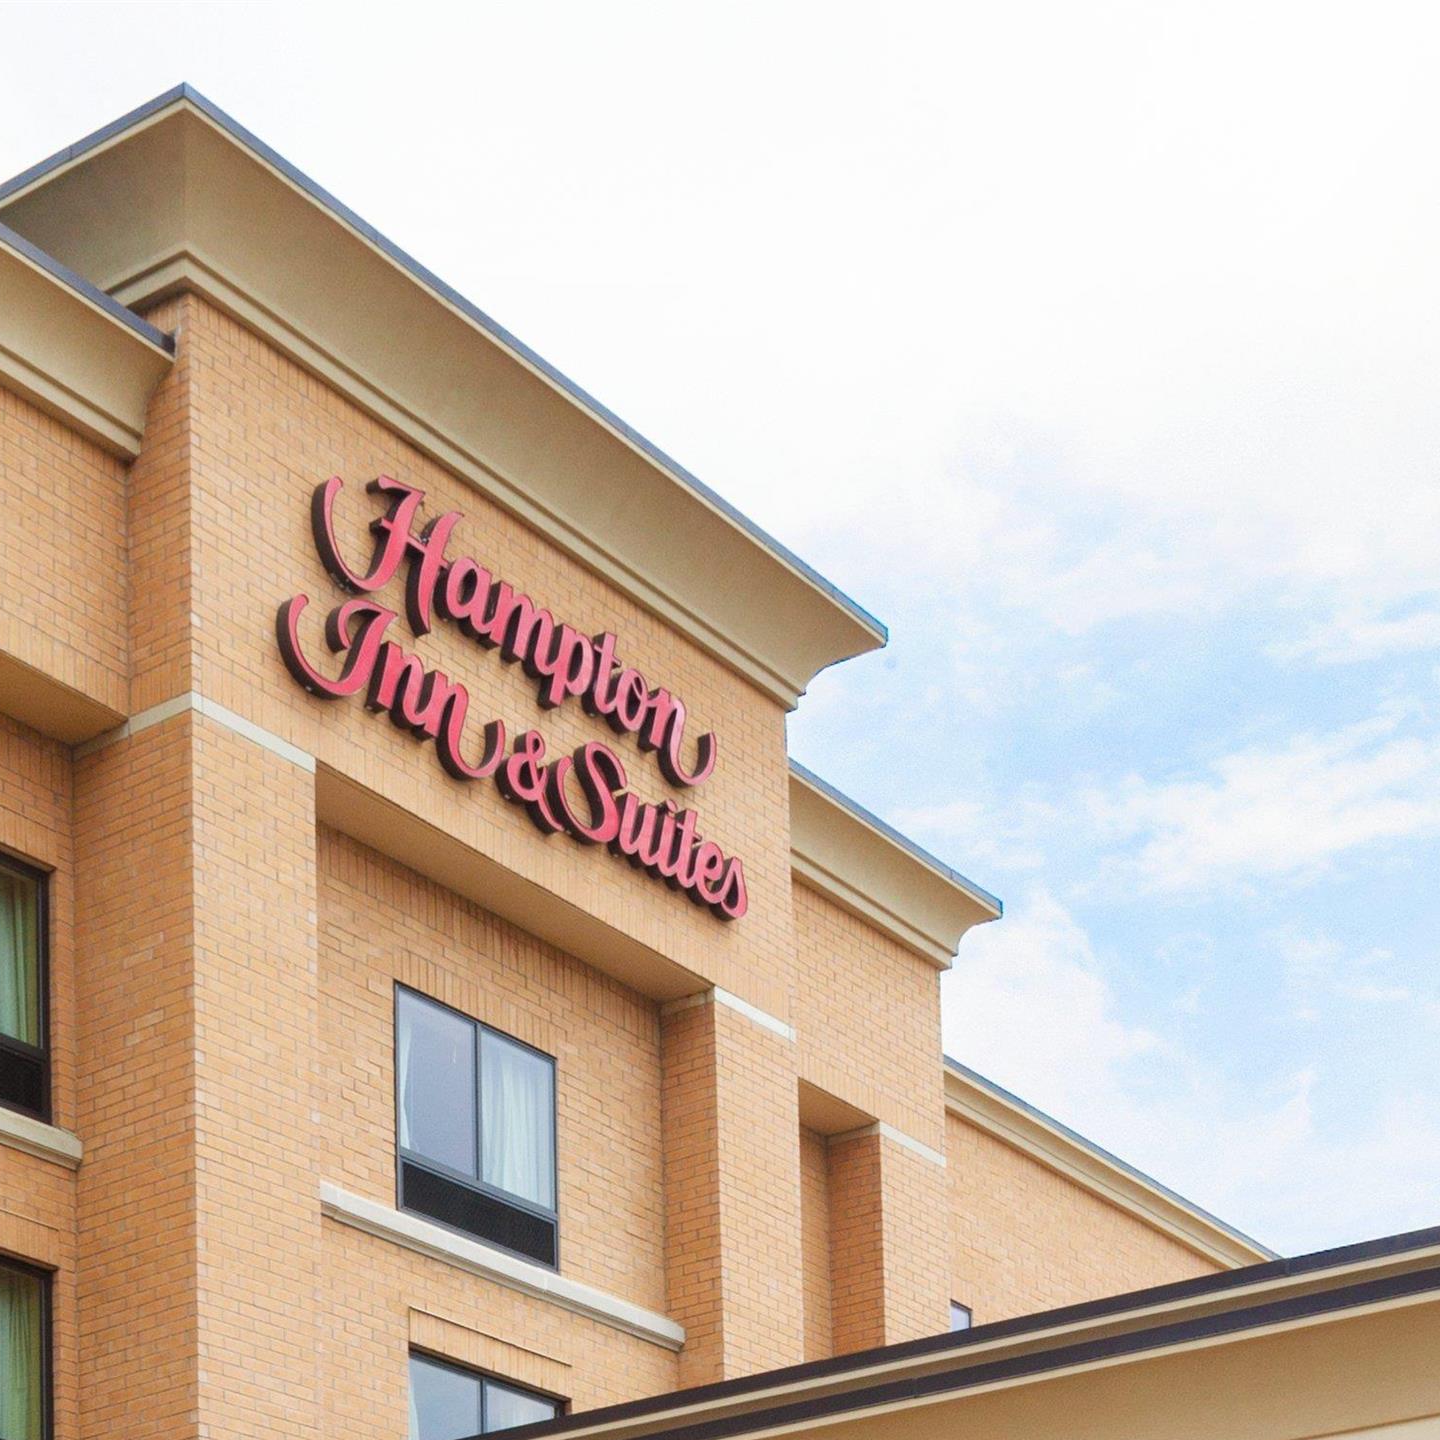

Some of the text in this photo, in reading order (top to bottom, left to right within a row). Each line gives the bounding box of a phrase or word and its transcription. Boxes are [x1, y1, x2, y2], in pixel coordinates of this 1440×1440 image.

[275, 593, 749, 922] Inn & Suites
[311, 473, 717, 788] Hampton
